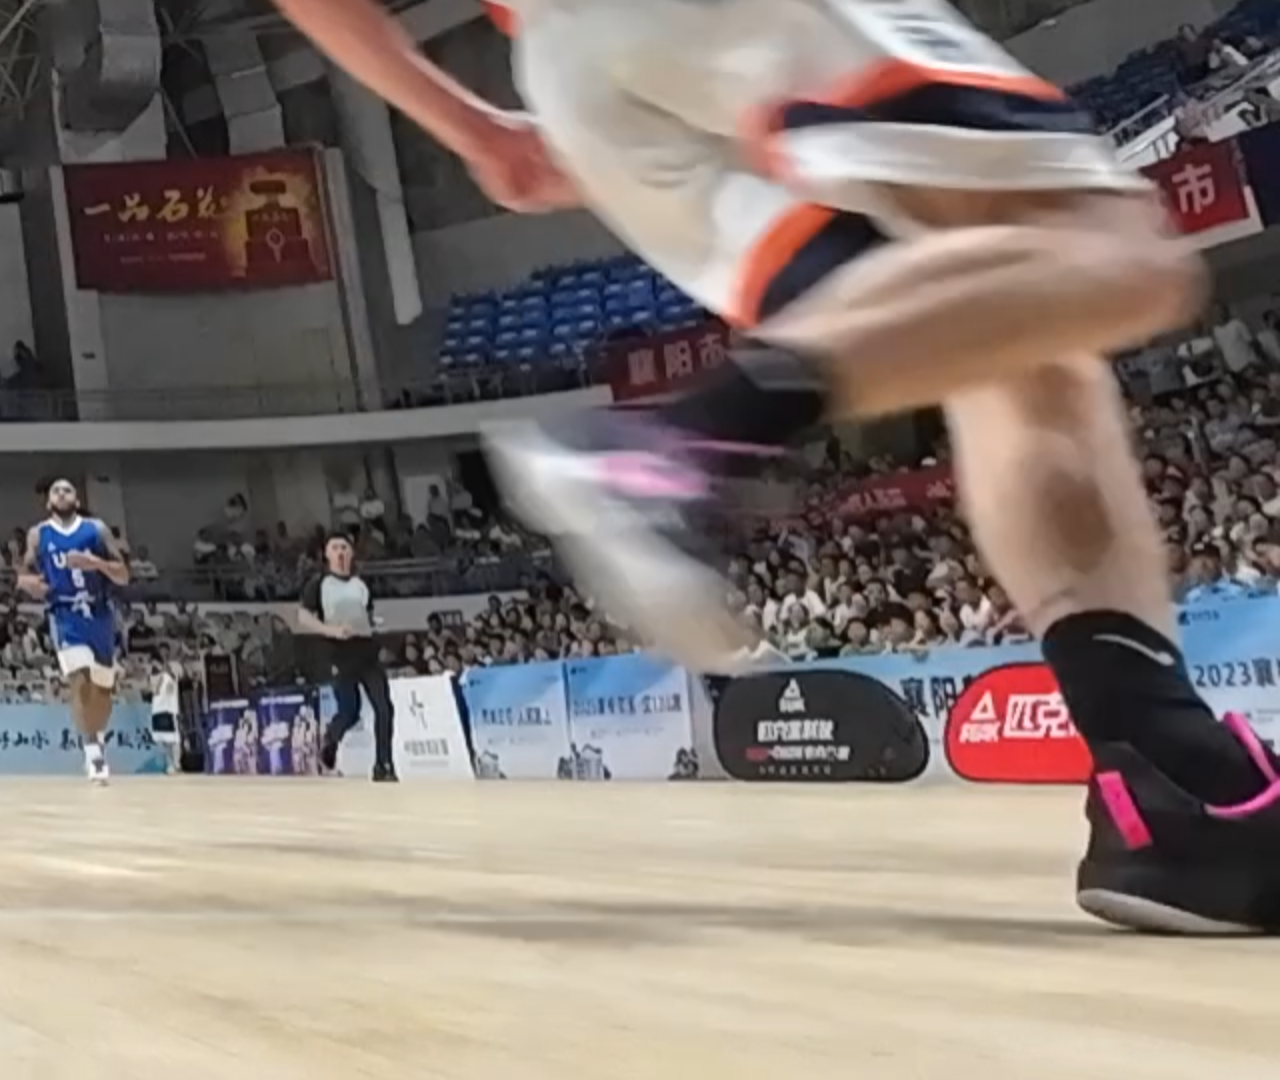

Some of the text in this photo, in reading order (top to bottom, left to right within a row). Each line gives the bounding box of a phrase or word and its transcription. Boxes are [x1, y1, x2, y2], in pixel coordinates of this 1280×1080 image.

[1171, 163, 1216, 215] 市
[1193, 657, 1280, 688] 2023襄
[900, 675, 973, 719] 襄阳
